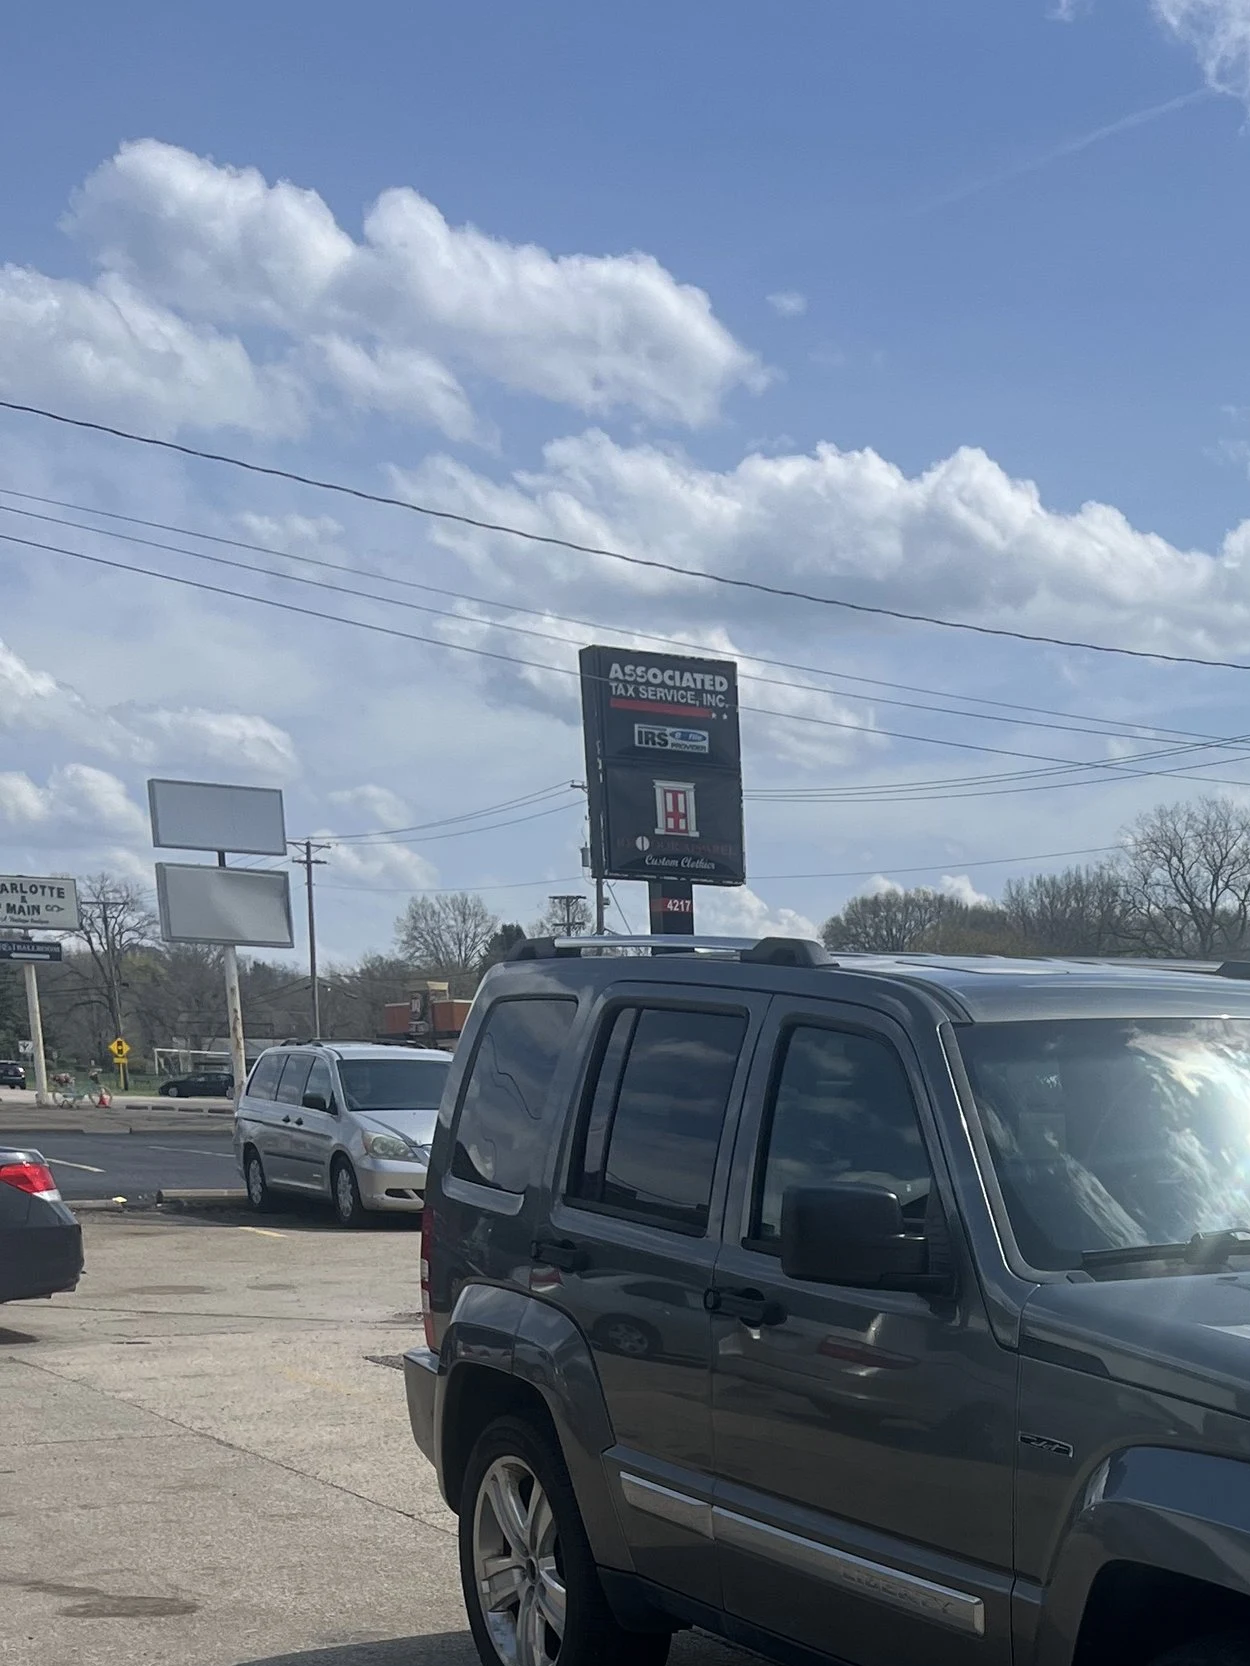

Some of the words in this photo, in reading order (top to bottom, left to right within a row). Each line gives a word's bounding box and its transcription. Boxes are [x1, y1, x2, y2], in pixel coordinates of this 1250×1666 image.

[608, 663, 728, 692] ASSOCIATED
[610, 682, 636, 697] TAX
[639, 685, 699, 707] SERVICE,
[702, 693, 729, 708] INC.
[637, 730, 668, 747] IRS
[645, 854, 679, 867] Custom
[680, 856, 715, 870] Clothier
[6, 903, 40, 916] MAIN
[667, 899, 691, 912] 4217
